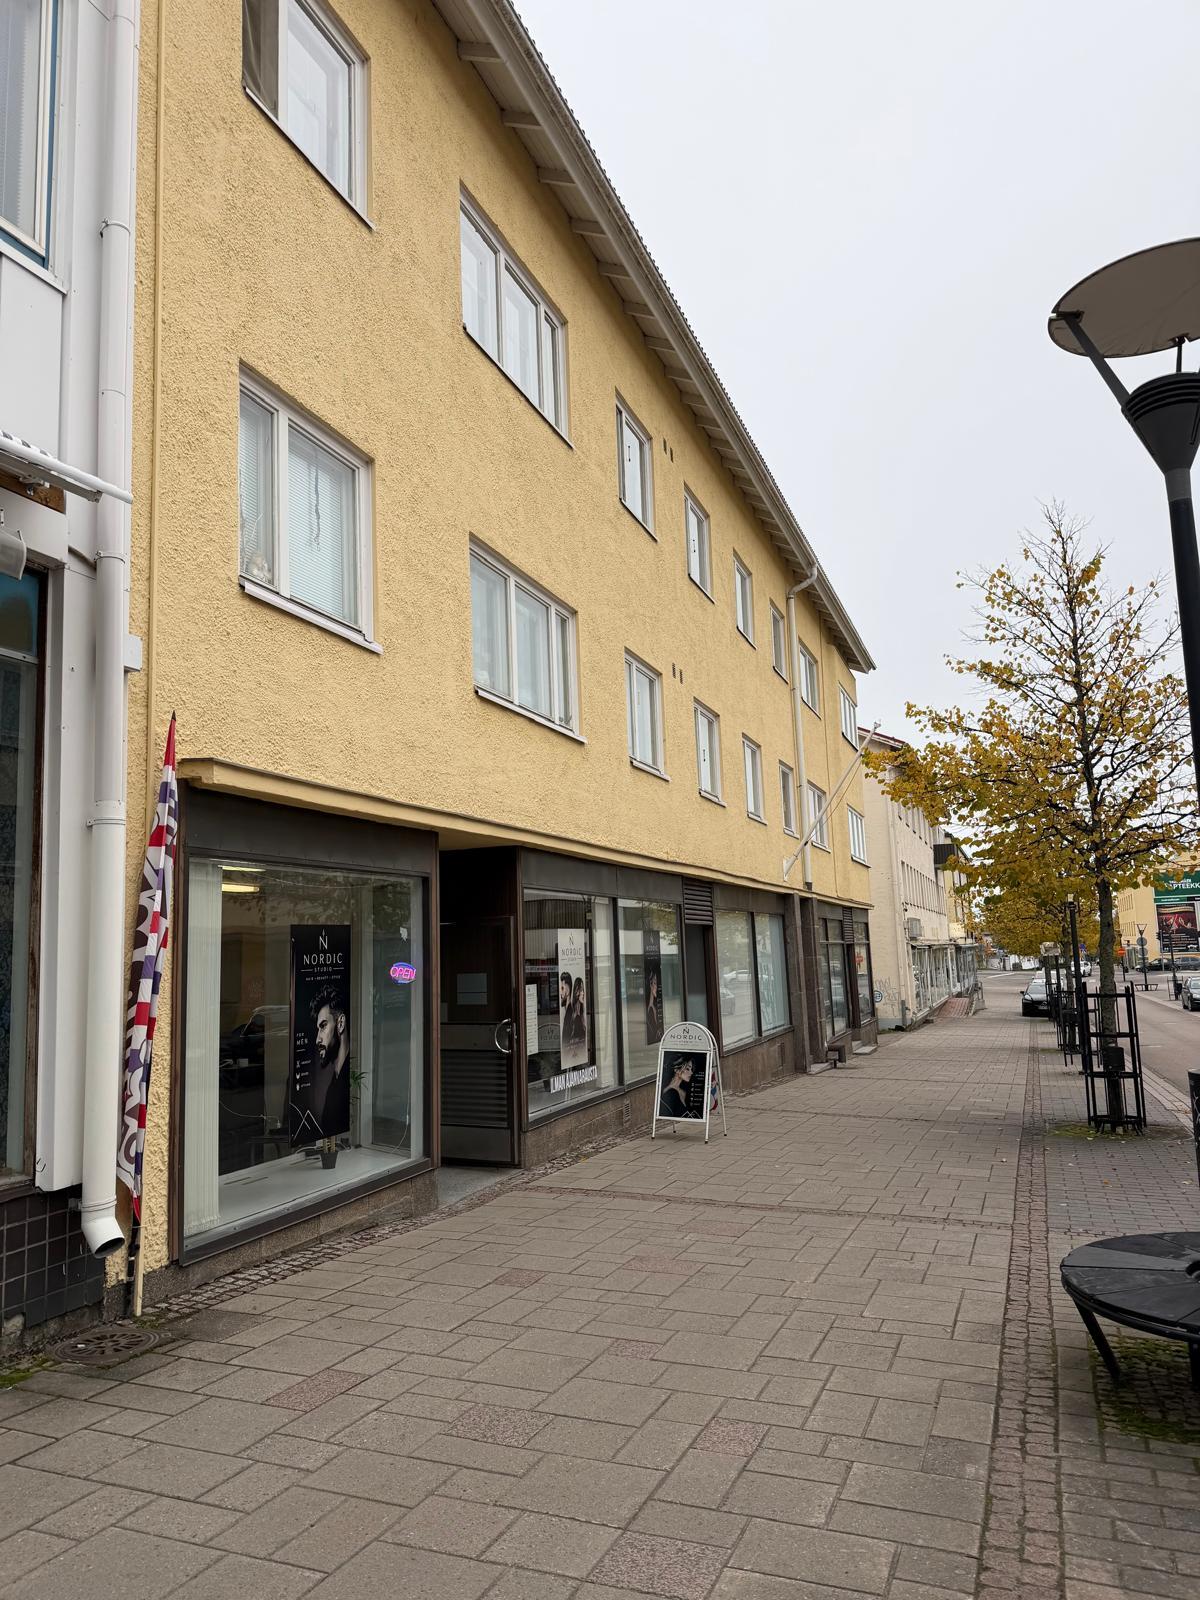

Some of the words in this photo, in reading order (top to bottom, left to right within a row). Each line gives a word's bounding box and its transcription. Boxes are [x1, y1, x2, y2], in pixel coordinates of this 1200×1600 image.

[561, 947, 582, 956] NORDIC
[303, 952, 343, 965] NORDIC
[390, 966, 416, 979] OPEN
